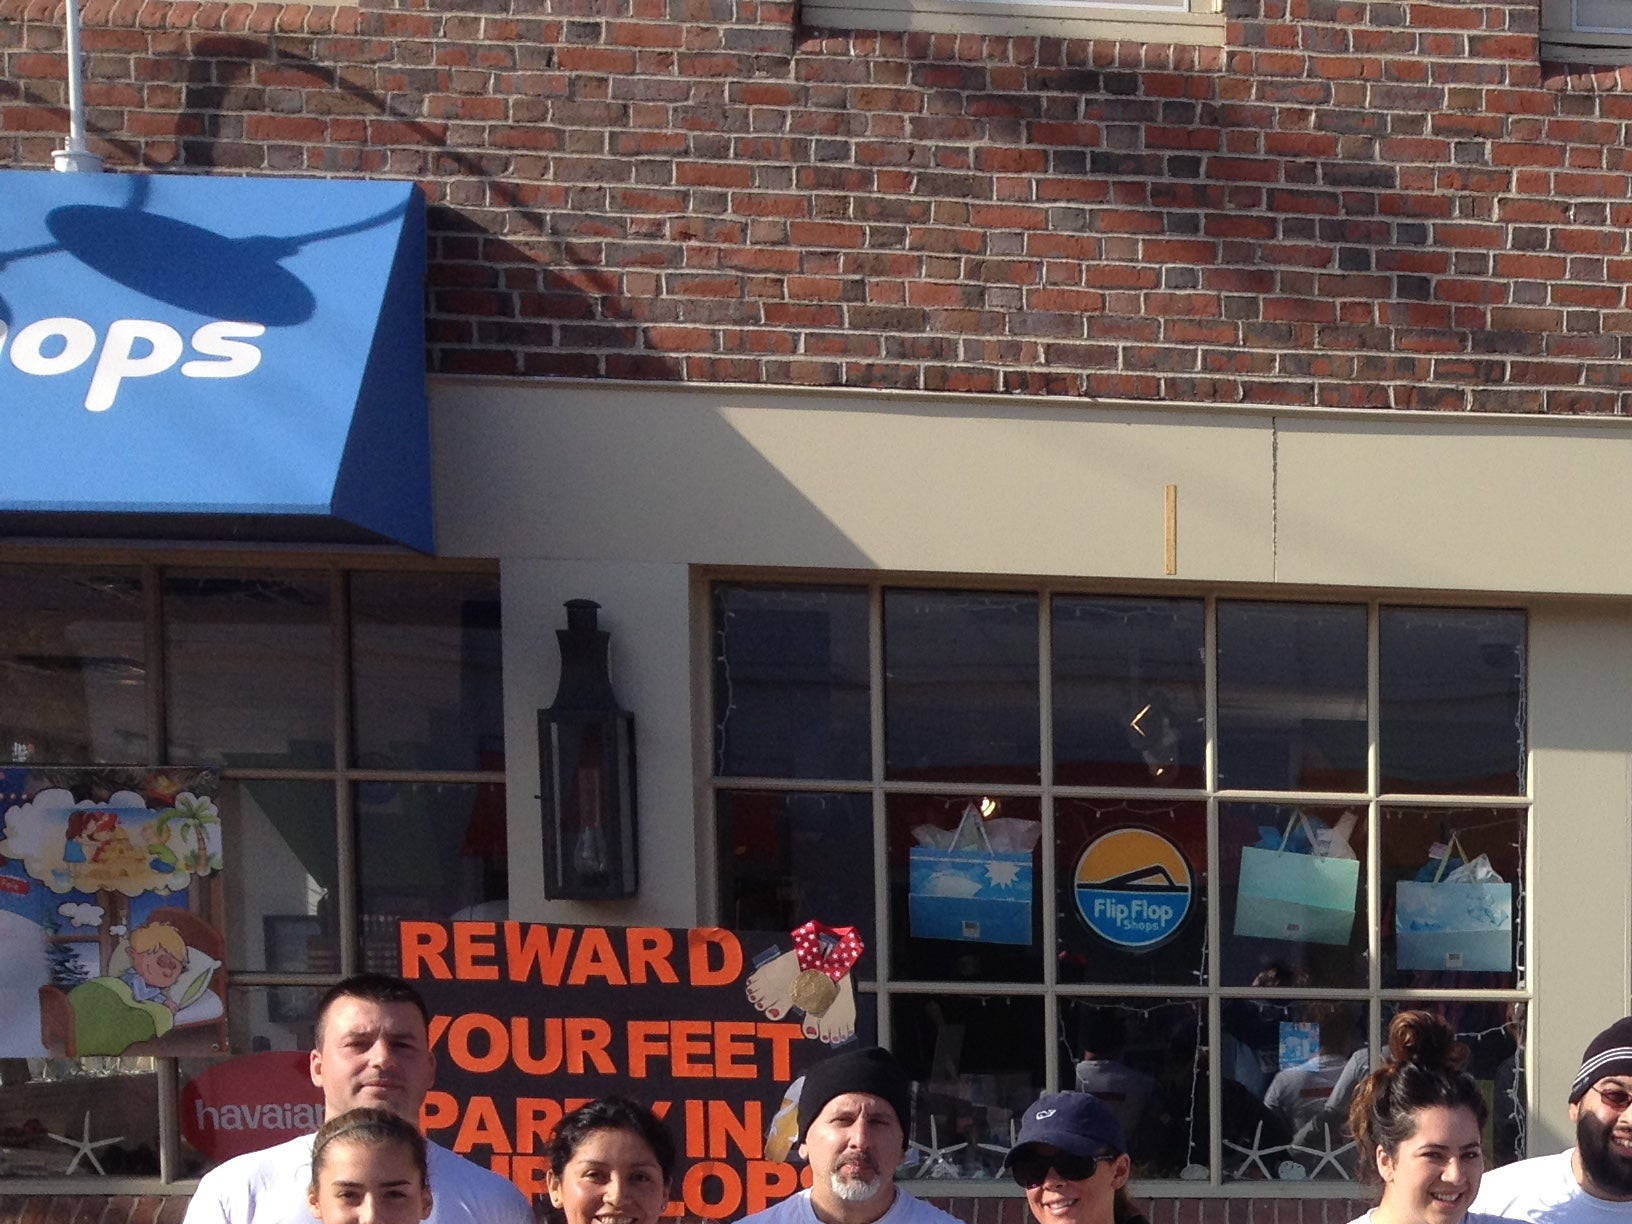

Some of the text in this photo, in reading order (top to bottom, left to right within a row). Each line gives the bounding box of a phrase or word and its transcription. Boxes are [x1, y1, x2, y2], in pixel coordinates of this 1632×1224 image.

[0, 317, 266, 412] ops
[1094, 898, 1174, 928] Flip Flop
[400, 920, 744, 987] REWARD
[627, 1020, 804, 1082] FEET
[418, 1091, 763, 1159] PAR IN
